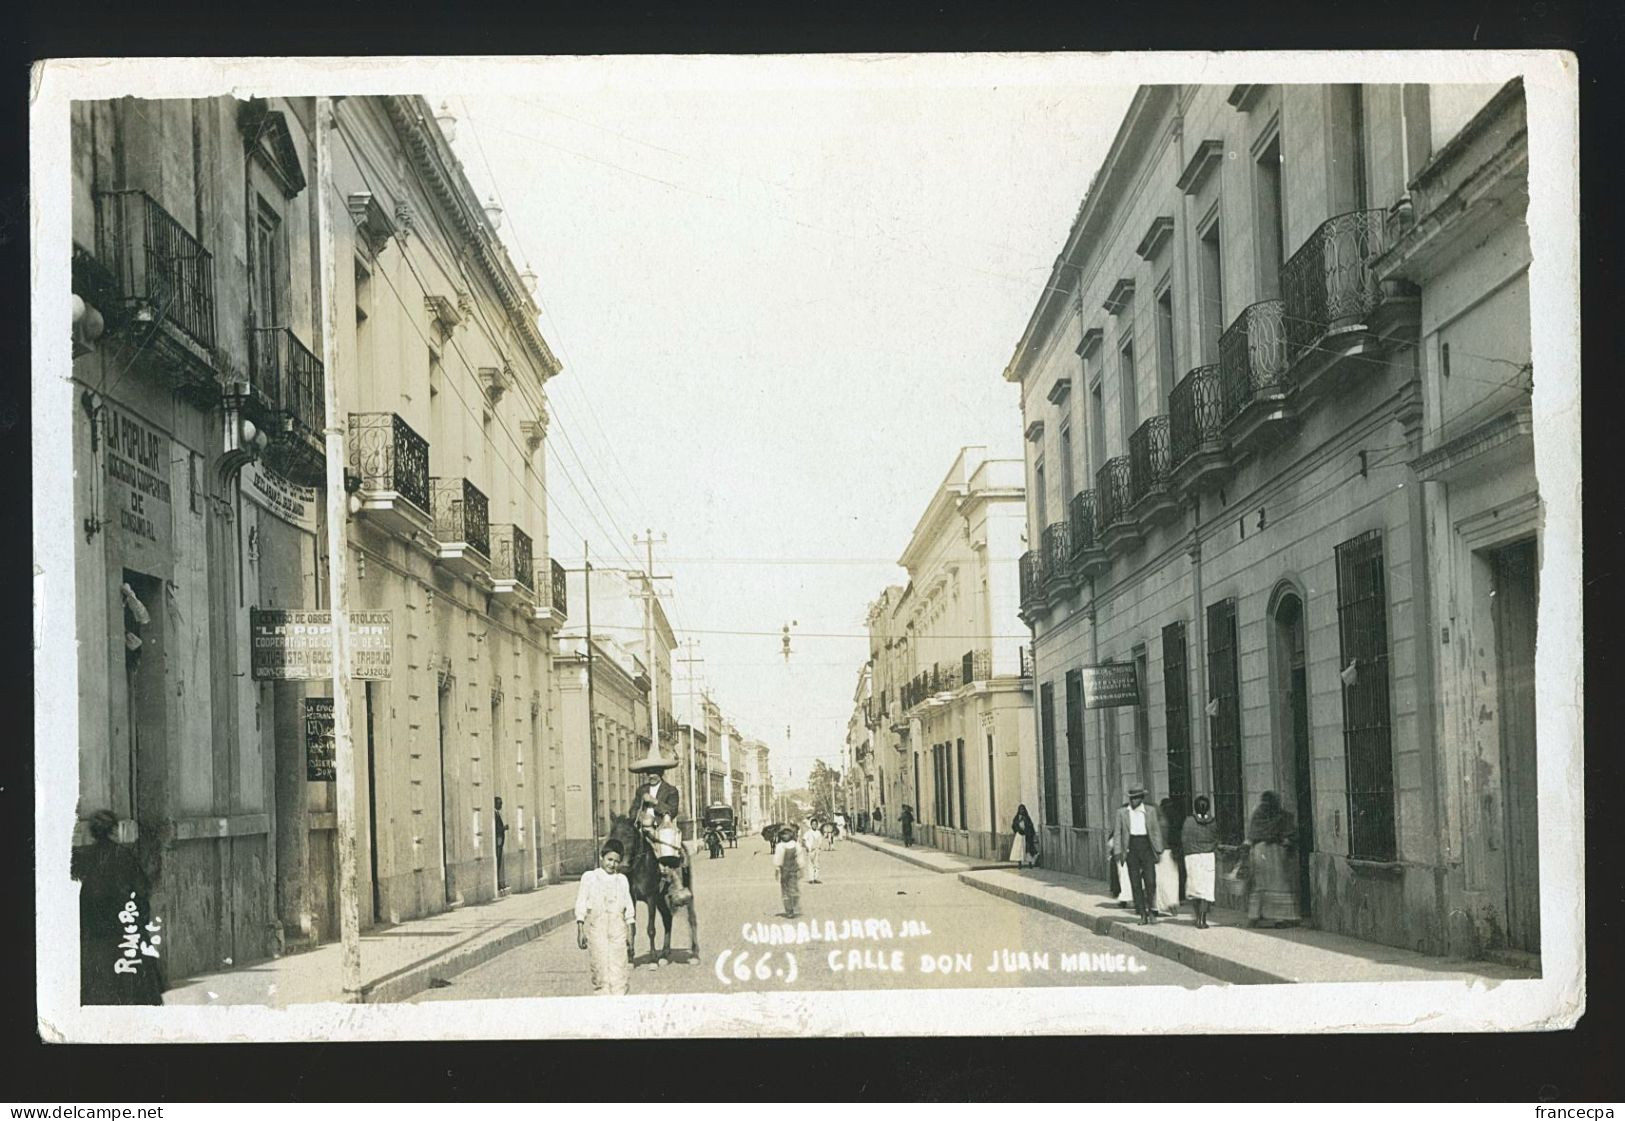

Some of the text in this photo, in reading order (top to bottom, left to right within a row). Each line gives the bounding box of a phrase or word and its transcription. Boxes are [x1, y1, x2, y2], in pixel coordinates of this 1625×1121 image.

[131, 491, 145, 515] DE
[295, 612, 306, 625] DE
[307, 612, 332, 625] OBRER
[255, 637, 306, 648] COOPERATIVA
[309, 637, 319, 648] DE
[305, 650, 311, 665] Y
[312, 650, 332, 665] BOLS
[356, 651, 391, 666] TRABAJO
